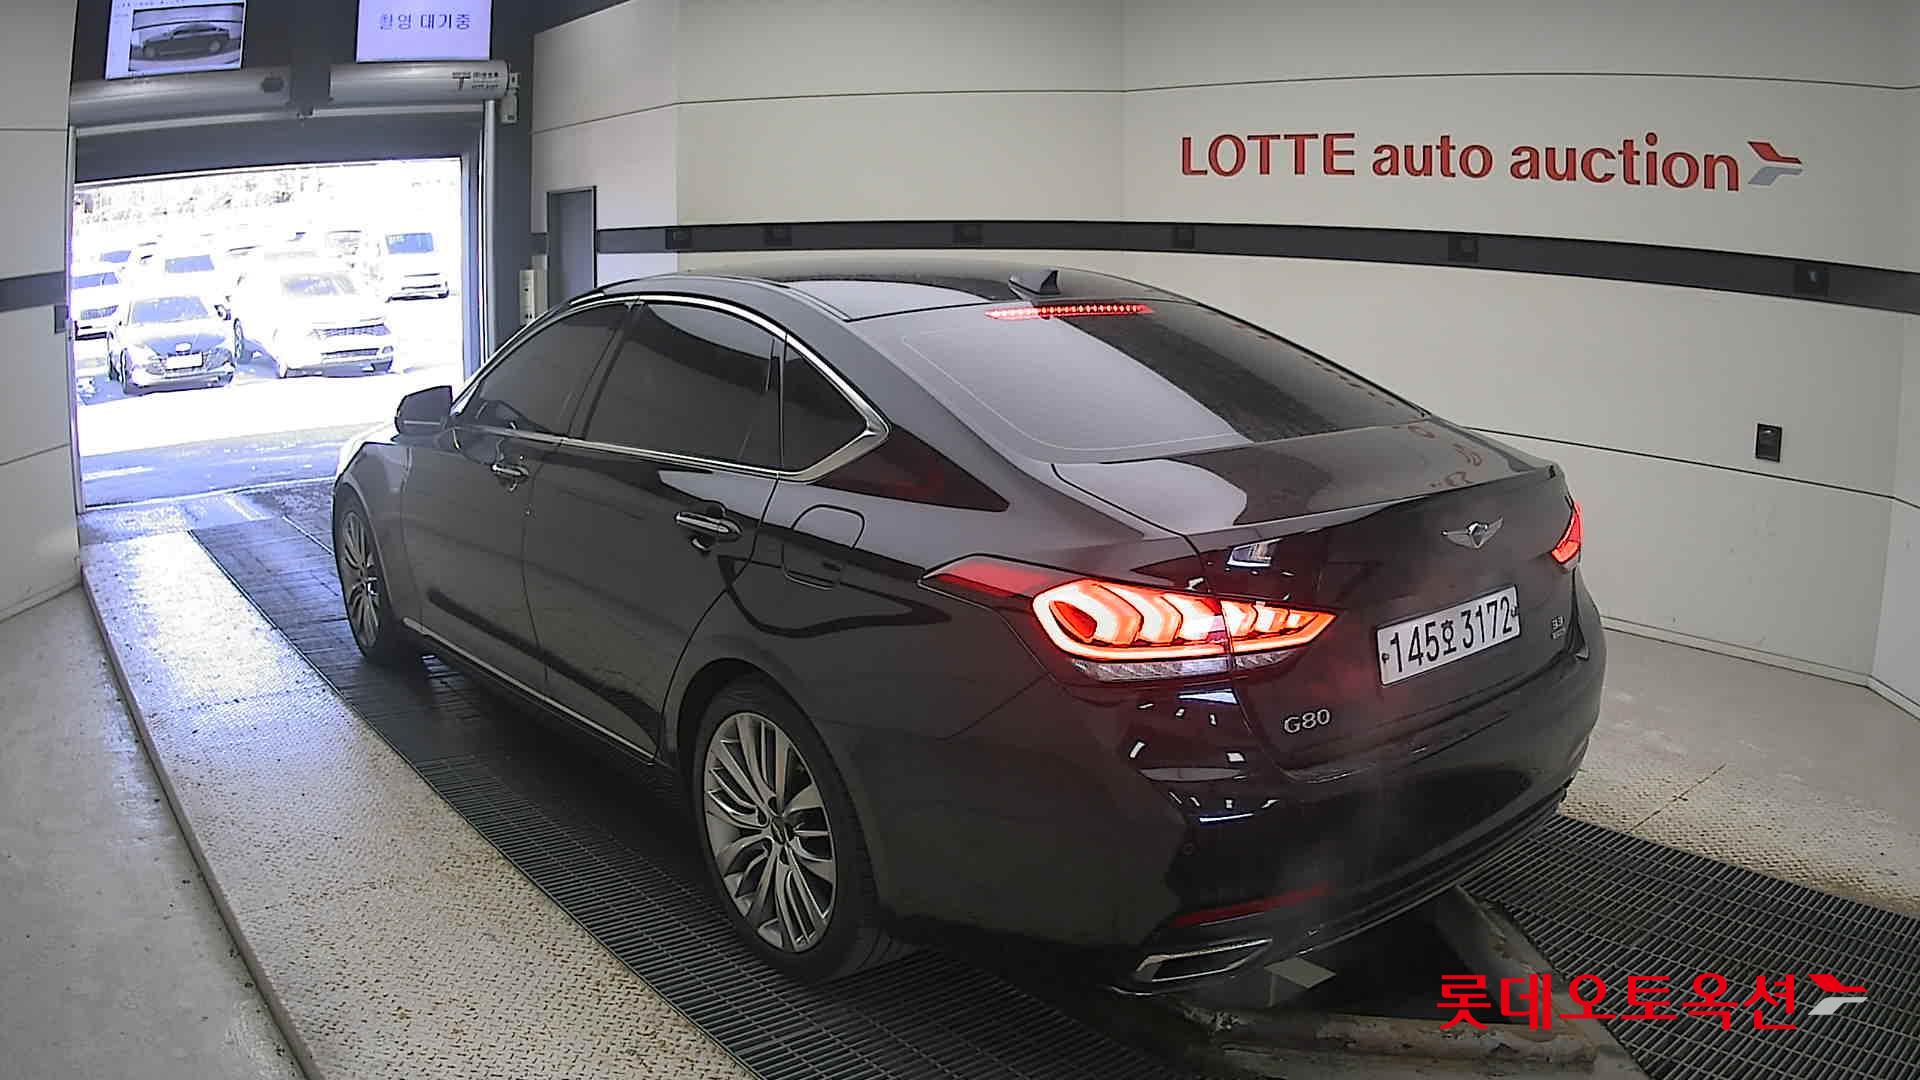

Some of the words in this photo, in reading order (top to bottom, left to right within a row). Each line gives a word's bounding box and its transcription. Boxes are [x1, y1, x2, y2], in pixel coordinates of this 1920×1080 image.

[420, 13, 472, 31] 대기중
[1180, 132, 1357, 177] LOTTE
[1372, 135, 1494, 180] auto
[1509, 132, 1741, 192] auction
[1283, 708, 1331, 734] G80
